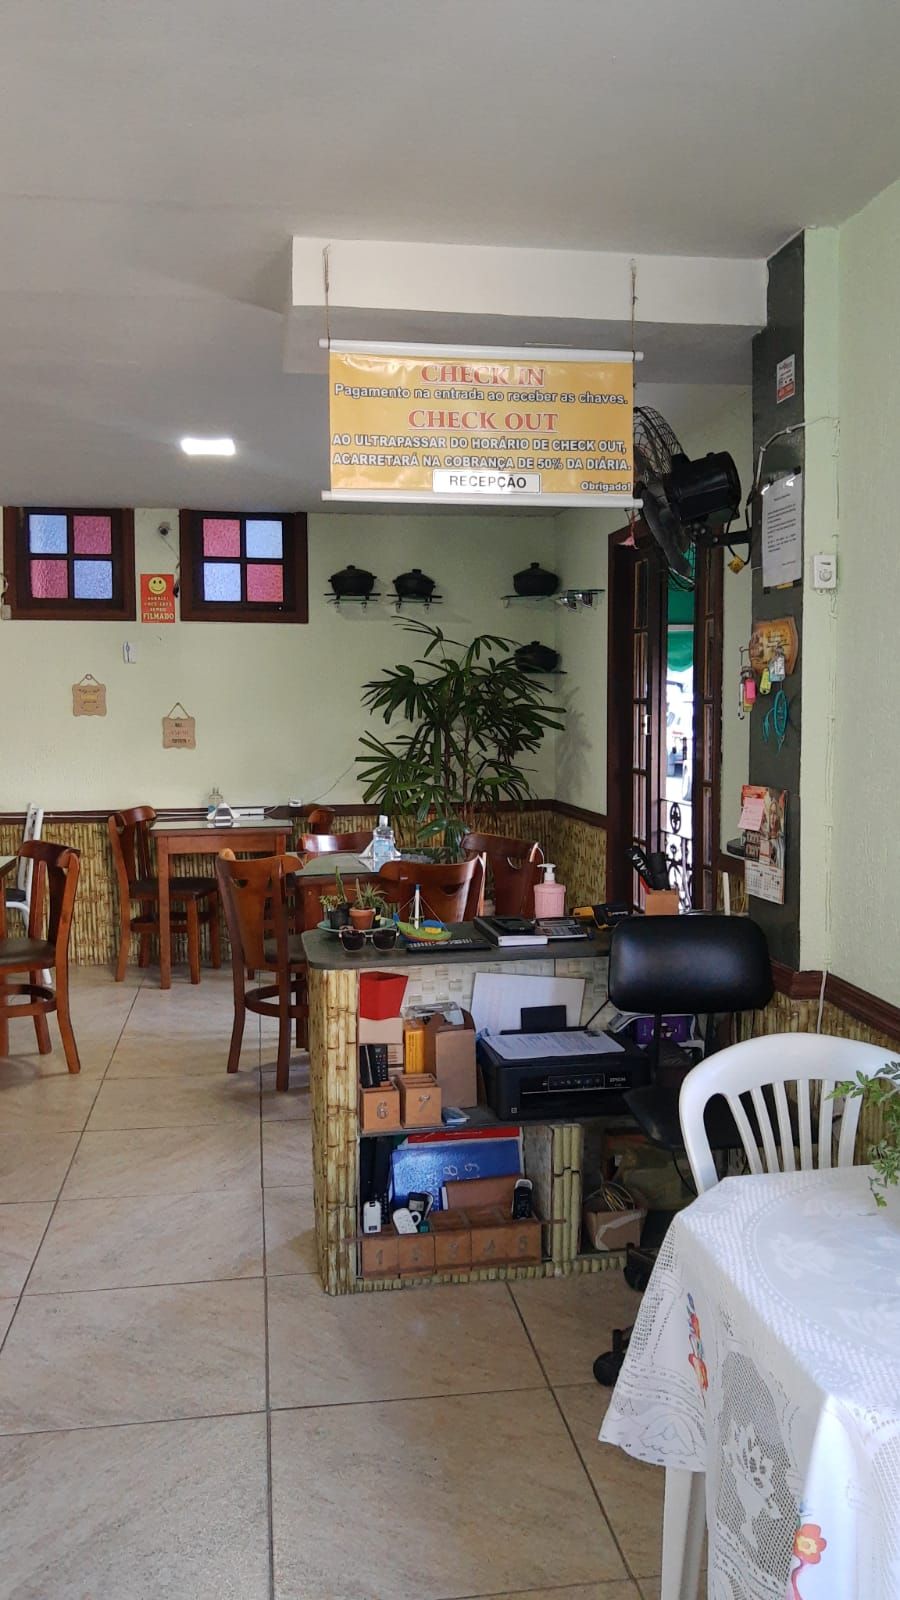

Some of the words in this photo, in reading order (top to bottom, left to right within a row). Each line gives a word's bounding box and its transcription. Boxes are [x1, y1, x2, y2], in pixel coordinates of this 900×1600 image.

[421, 365, 510, 384] CHECK
[518, 367, 545, 386] IN
[334, 383, 410, 399] Pagamento
[414, 388, 431, 399] na
[434, 387, 484, 400] entrada
[488, 391, 504, 401] ao
[508, 390, 558, 402] receber
[560, 392, 575, 403] as
[579, 391, 628, 404] chaves.
[408, 410, 497, 430] CHECK
[505, 412, 558, 431] OUT
[332, 434, 351, 446] AO
[355, 434, 446, 448] ULTRAPASSAR
[450, 437, 468, 449] DO
[471, 436, 529, 450] HORÁRIO
[533, 439, 549, 450] DE
[552, 440, 595, 451] CHECK
[598, 441, 626, 454] OUT,
[332, 452, 419, 467] ACARRETARÁ
[423, 455, 441, 467] NA
[444, 455, 515, 470] COBRANÇA
[517, 457, 534, 469] DE
[537, 458, 563, 470] 50%
[566, 459, 583, 471] DA
[586, 456, 631, 471] DIÁRIA.
[449, 474, 527, 490] RECEPÇÃO
[580, 481, 632, 493] Obrigado!
[143, 612, 174, 620] FILMADO
[376, 1101, 389, 1119] 6
[418, 1095, 431, 1112] 7
